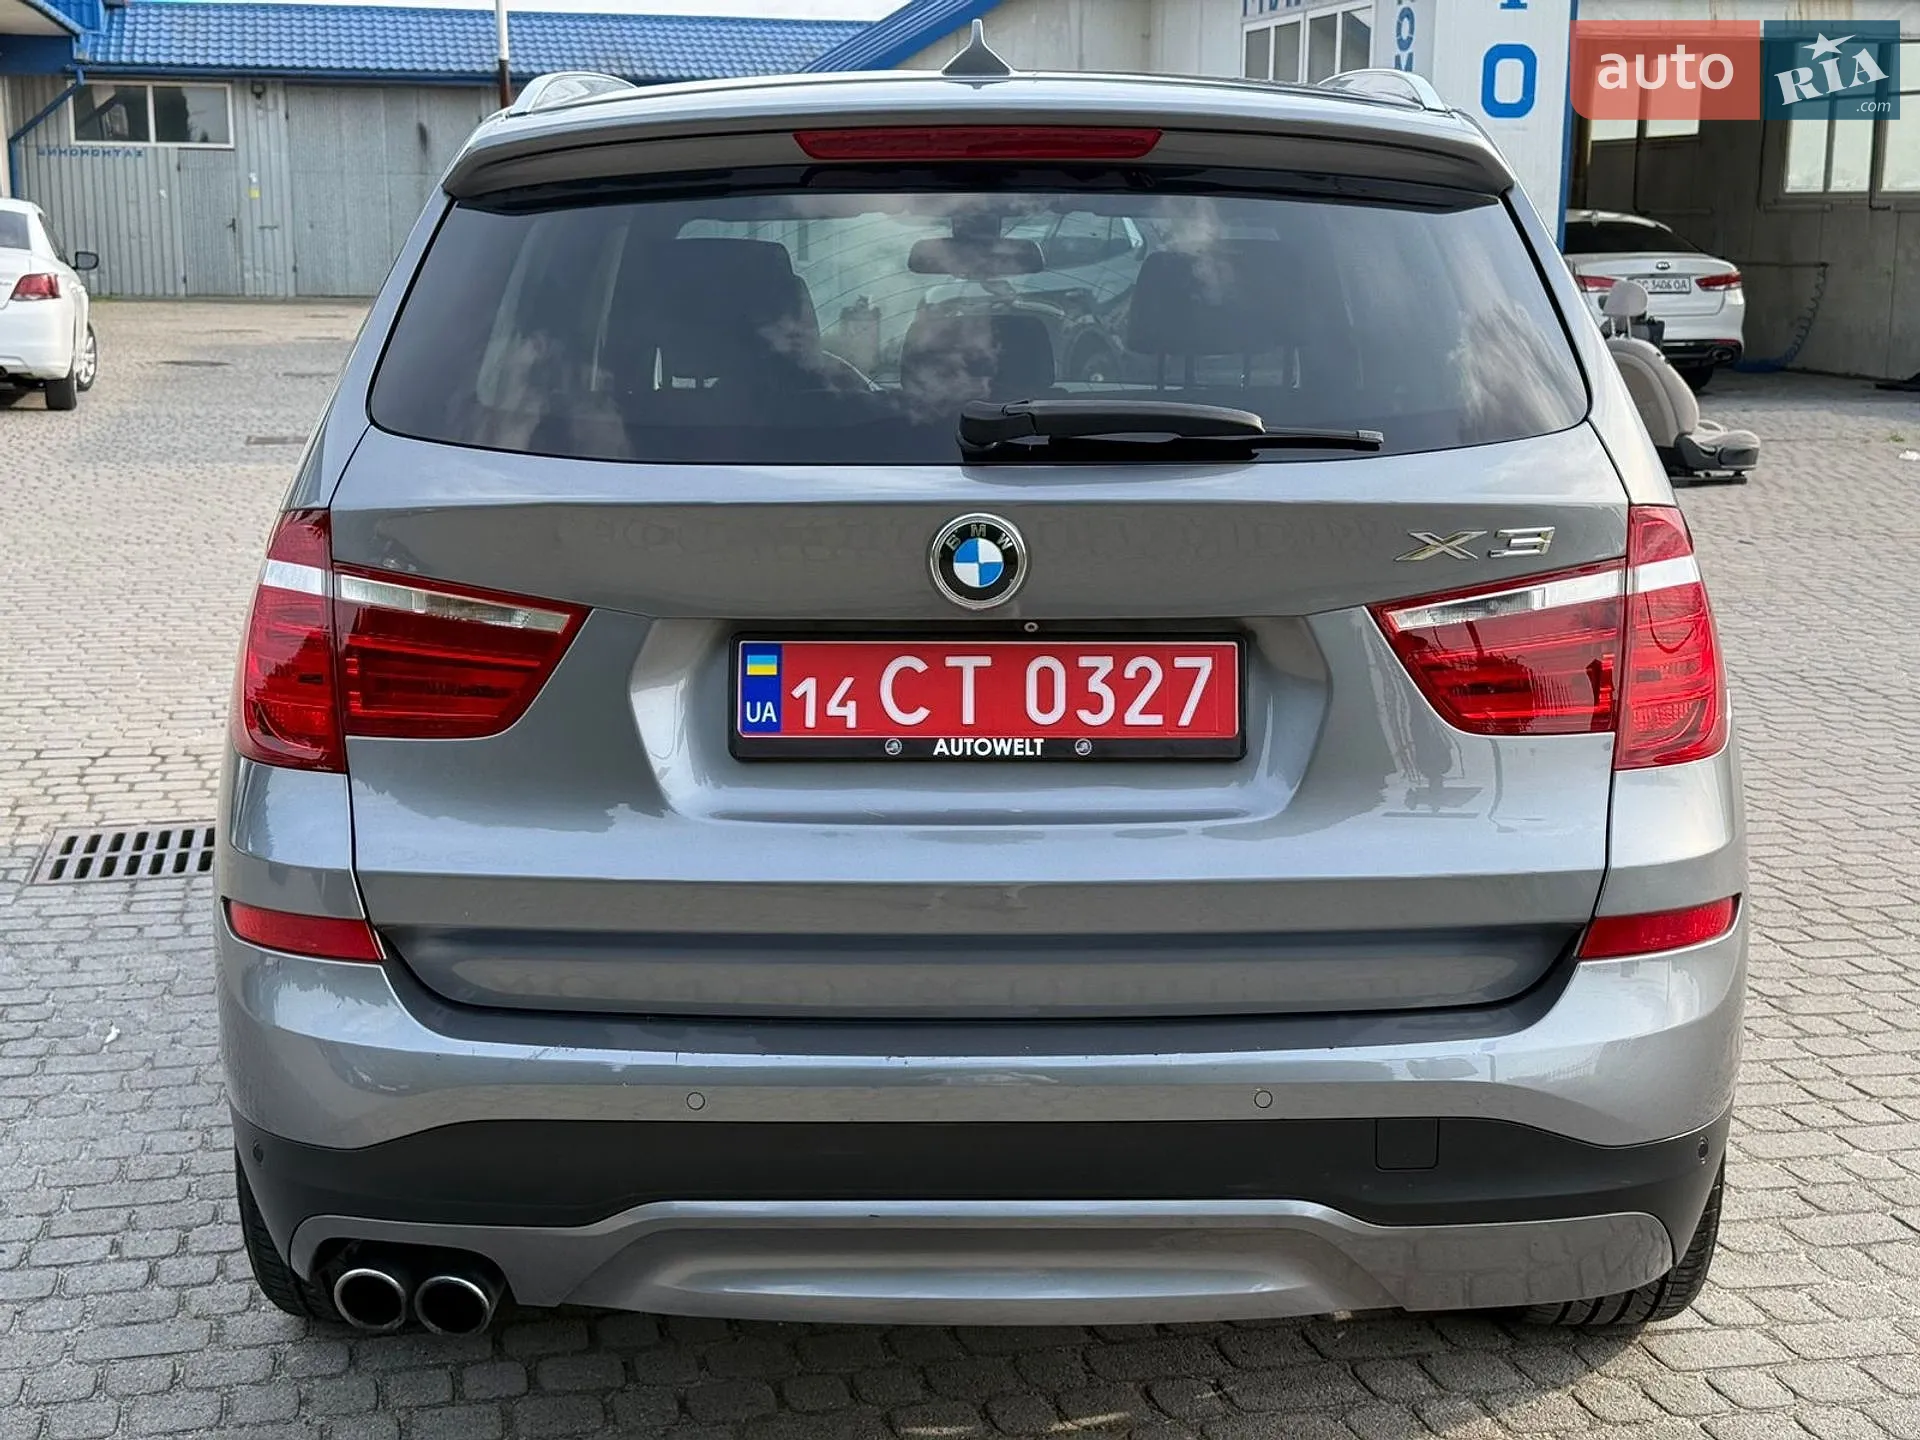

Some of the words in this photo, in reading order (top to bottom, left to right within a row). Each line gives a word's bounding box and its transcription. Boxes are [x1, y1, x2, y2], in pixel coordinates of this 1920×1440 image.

[945, 524, 1014, 552] BMW
[1392, 526, 1556, 562] X3
[790, 676, 857, 729] 14
[879, 655, 992, 726] CT
[1025, 655, 1214, 728] 0327
[746, 701, 777, 723] UA
[933, 737, 1045, 757] AUTOWELT
